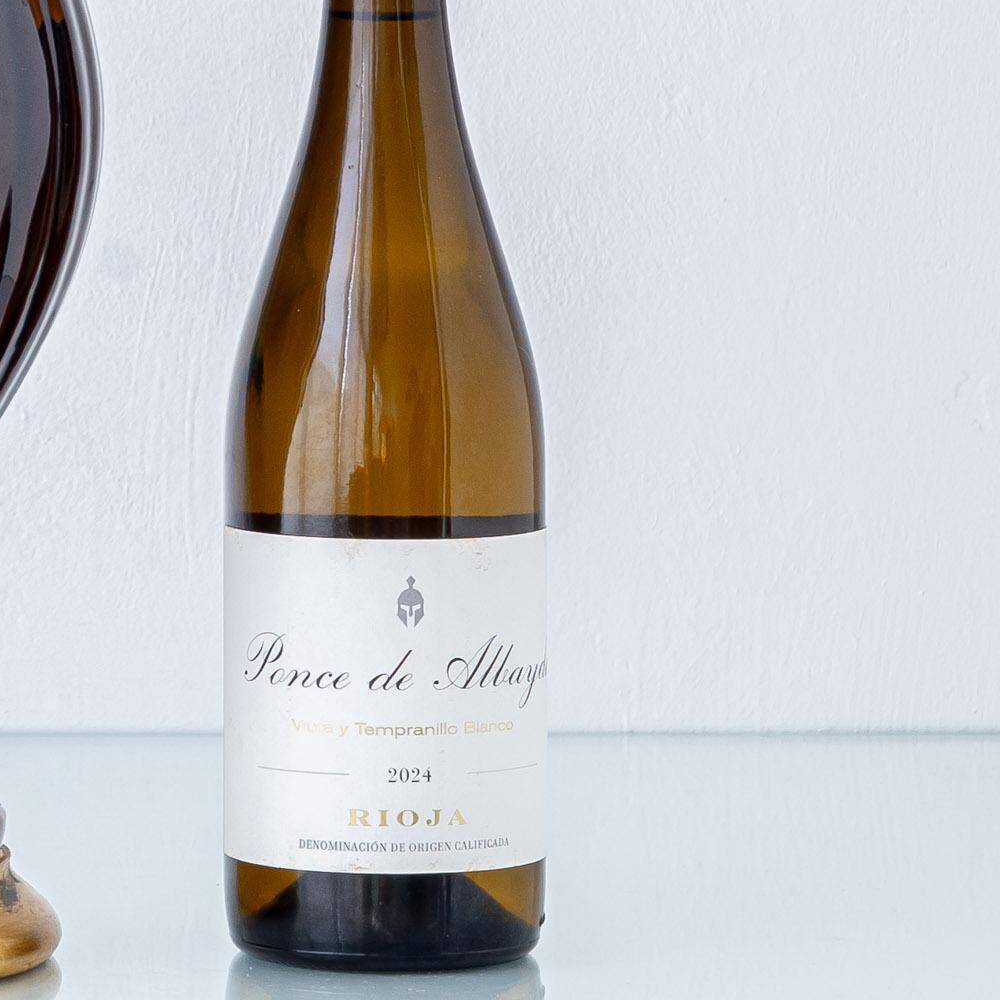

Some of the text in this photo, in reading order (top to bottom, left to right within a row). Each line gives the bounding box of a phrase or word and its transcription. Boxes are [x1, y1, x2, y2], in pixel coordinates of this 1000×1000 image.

[244, 631, 548, 709] Ponce de Albayd
[291, 718, 514, 739] Viura y Tempranillo Blanco
[387, 766, 432, 783] 2024
[347, 808, 467, 827] RIOJA
[298, 837, 510, 853] DENOMINACIÓN DE ORIGEN CALIFICADA
